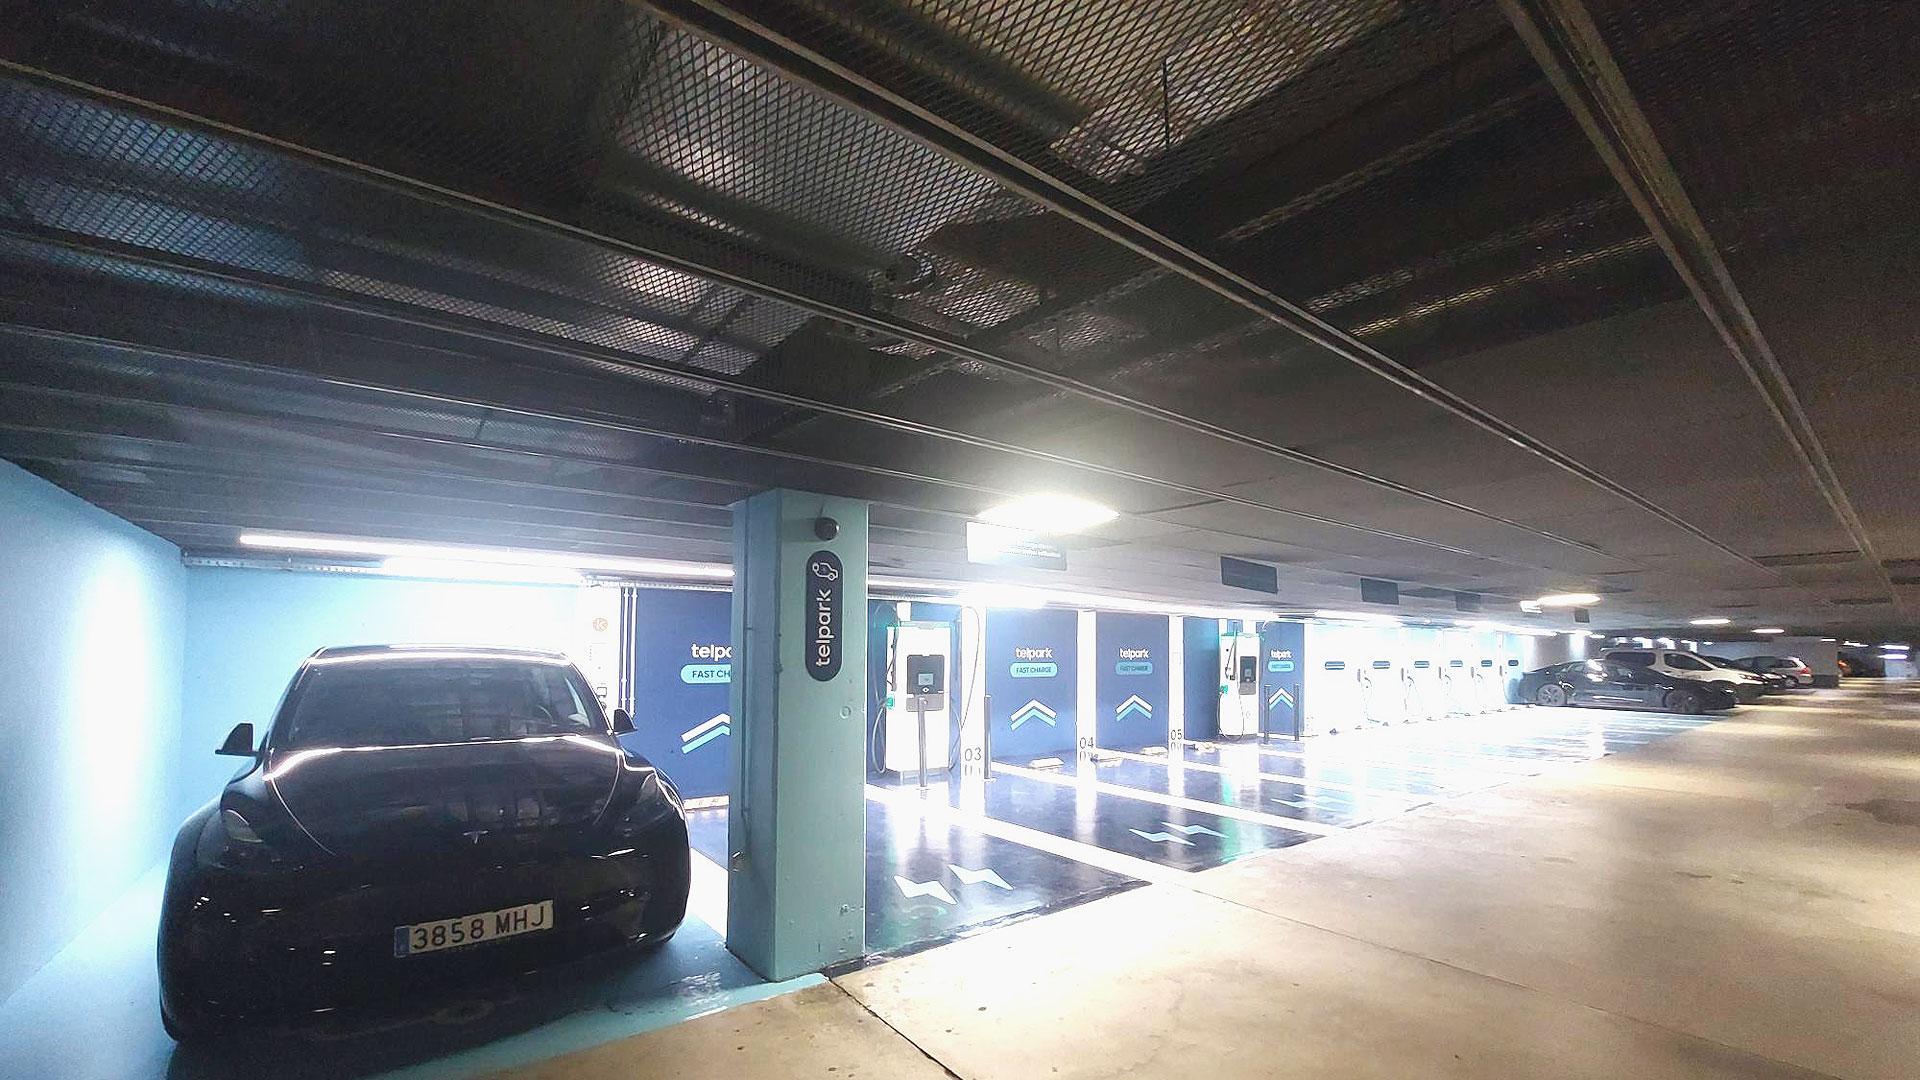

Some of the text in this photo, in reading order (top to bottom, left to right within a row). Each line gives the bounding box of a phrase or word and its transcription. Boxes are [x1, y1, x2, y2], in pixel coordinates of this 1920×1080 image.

[815, 588, 835, 667] telpark
[1015, 647, 1053, 661] telpark
[692, 670, 715, 678] FAST
[1170, 729, 1183, 741] 05
[1079, 737, 1094, 749] 04
[965, 746, 982, 761] 03
[413, 905, 545, 950] 3858 MHJ
